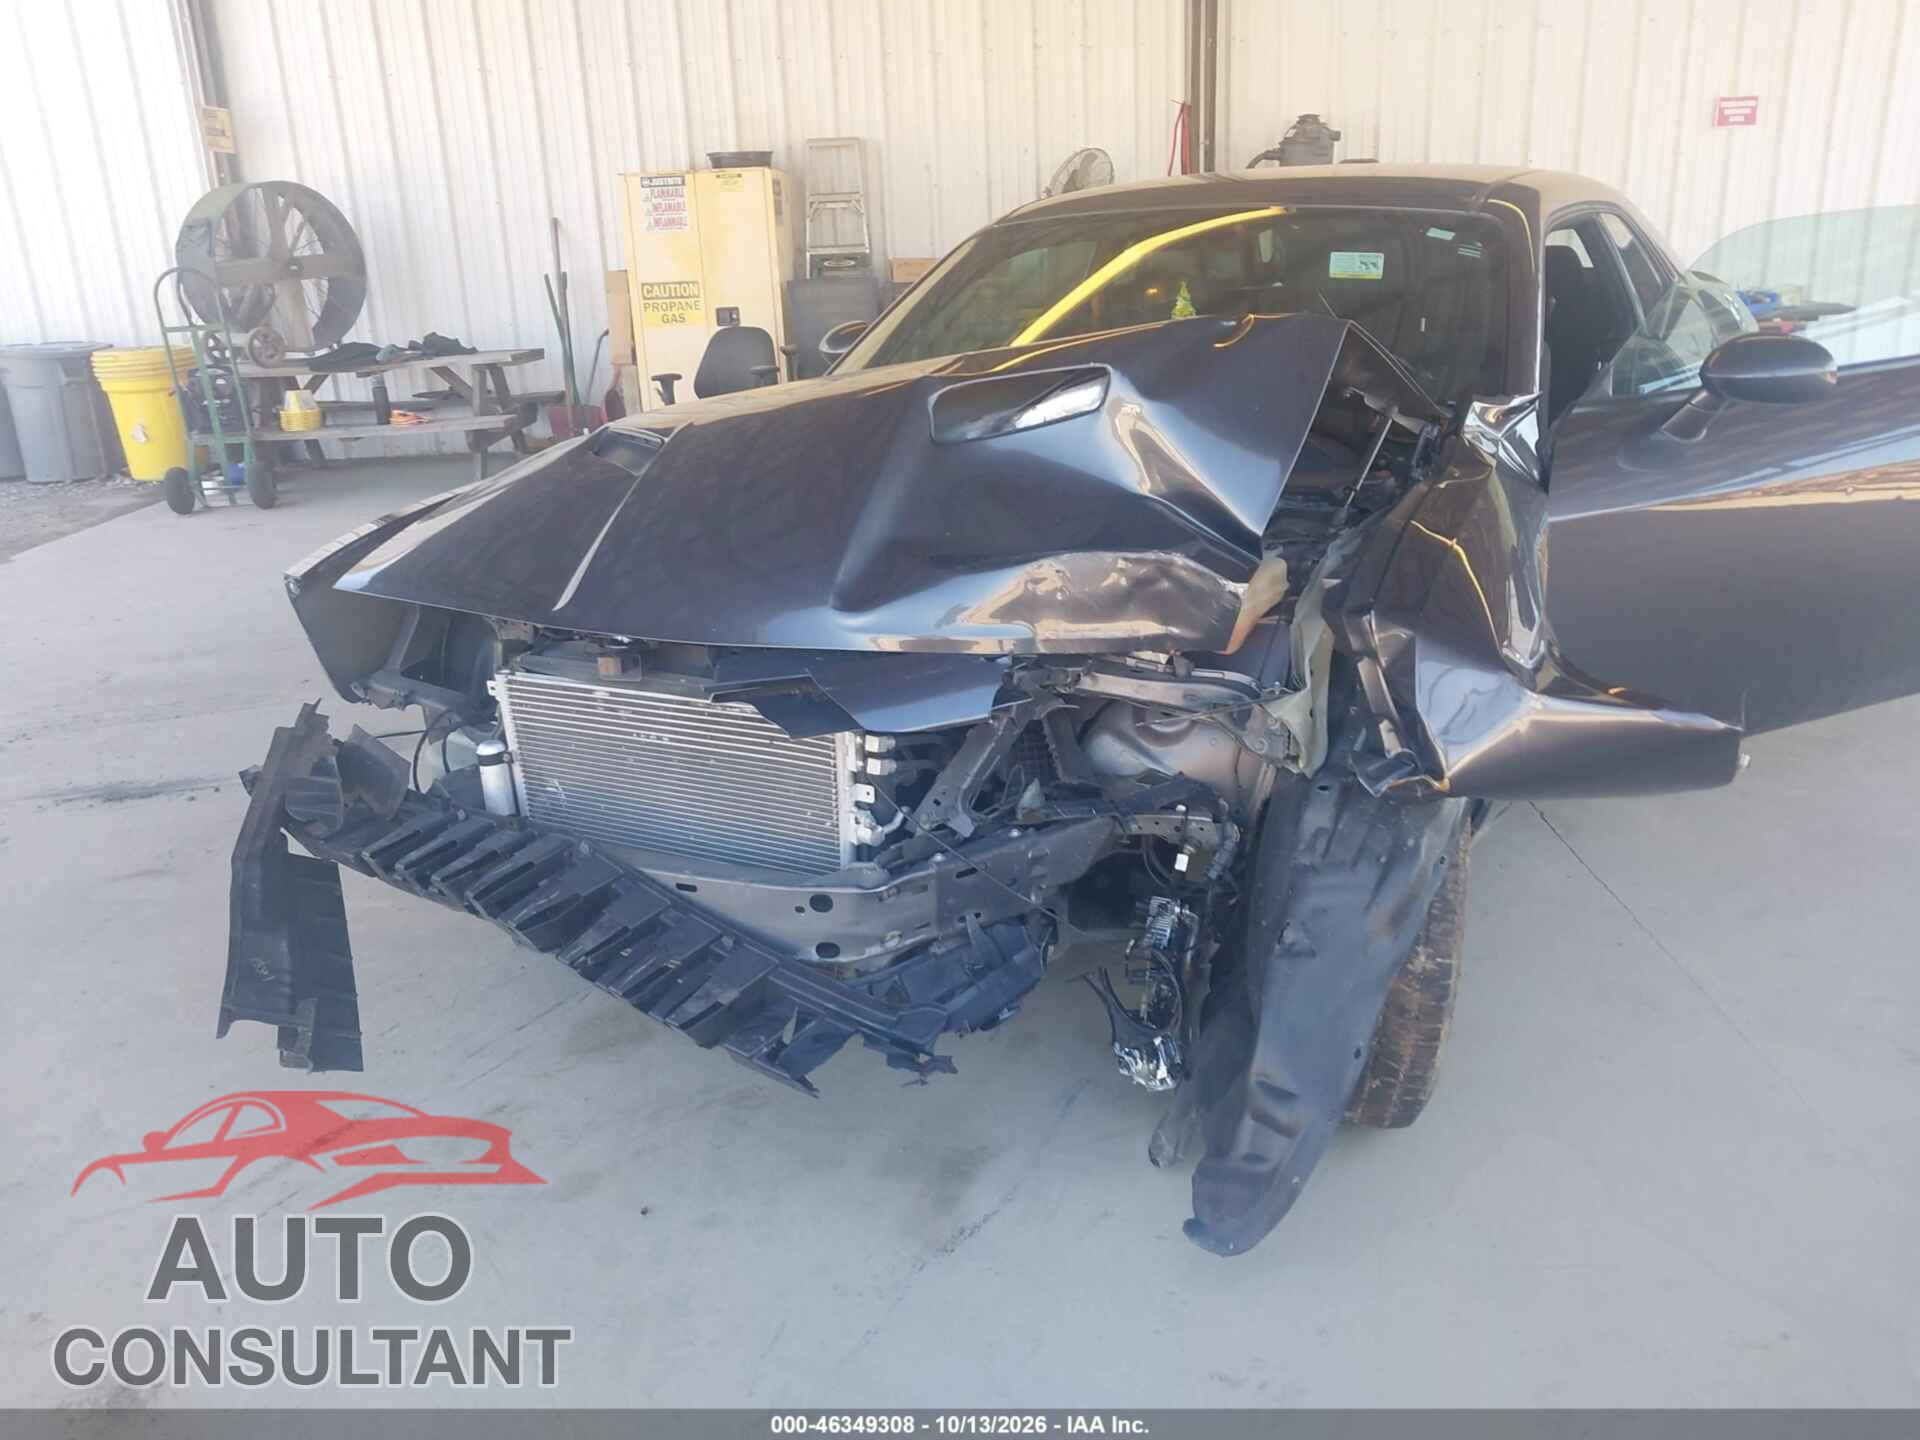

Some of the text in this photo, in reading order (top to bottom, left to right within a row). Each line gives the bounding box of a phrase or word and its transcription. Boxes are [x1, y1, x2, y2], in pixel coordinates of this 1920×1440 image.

[643, 283, 699, 298] CAUTION
[643, 300, 701, 312] PROPANE
[662, 313, 686, 324] GAS
